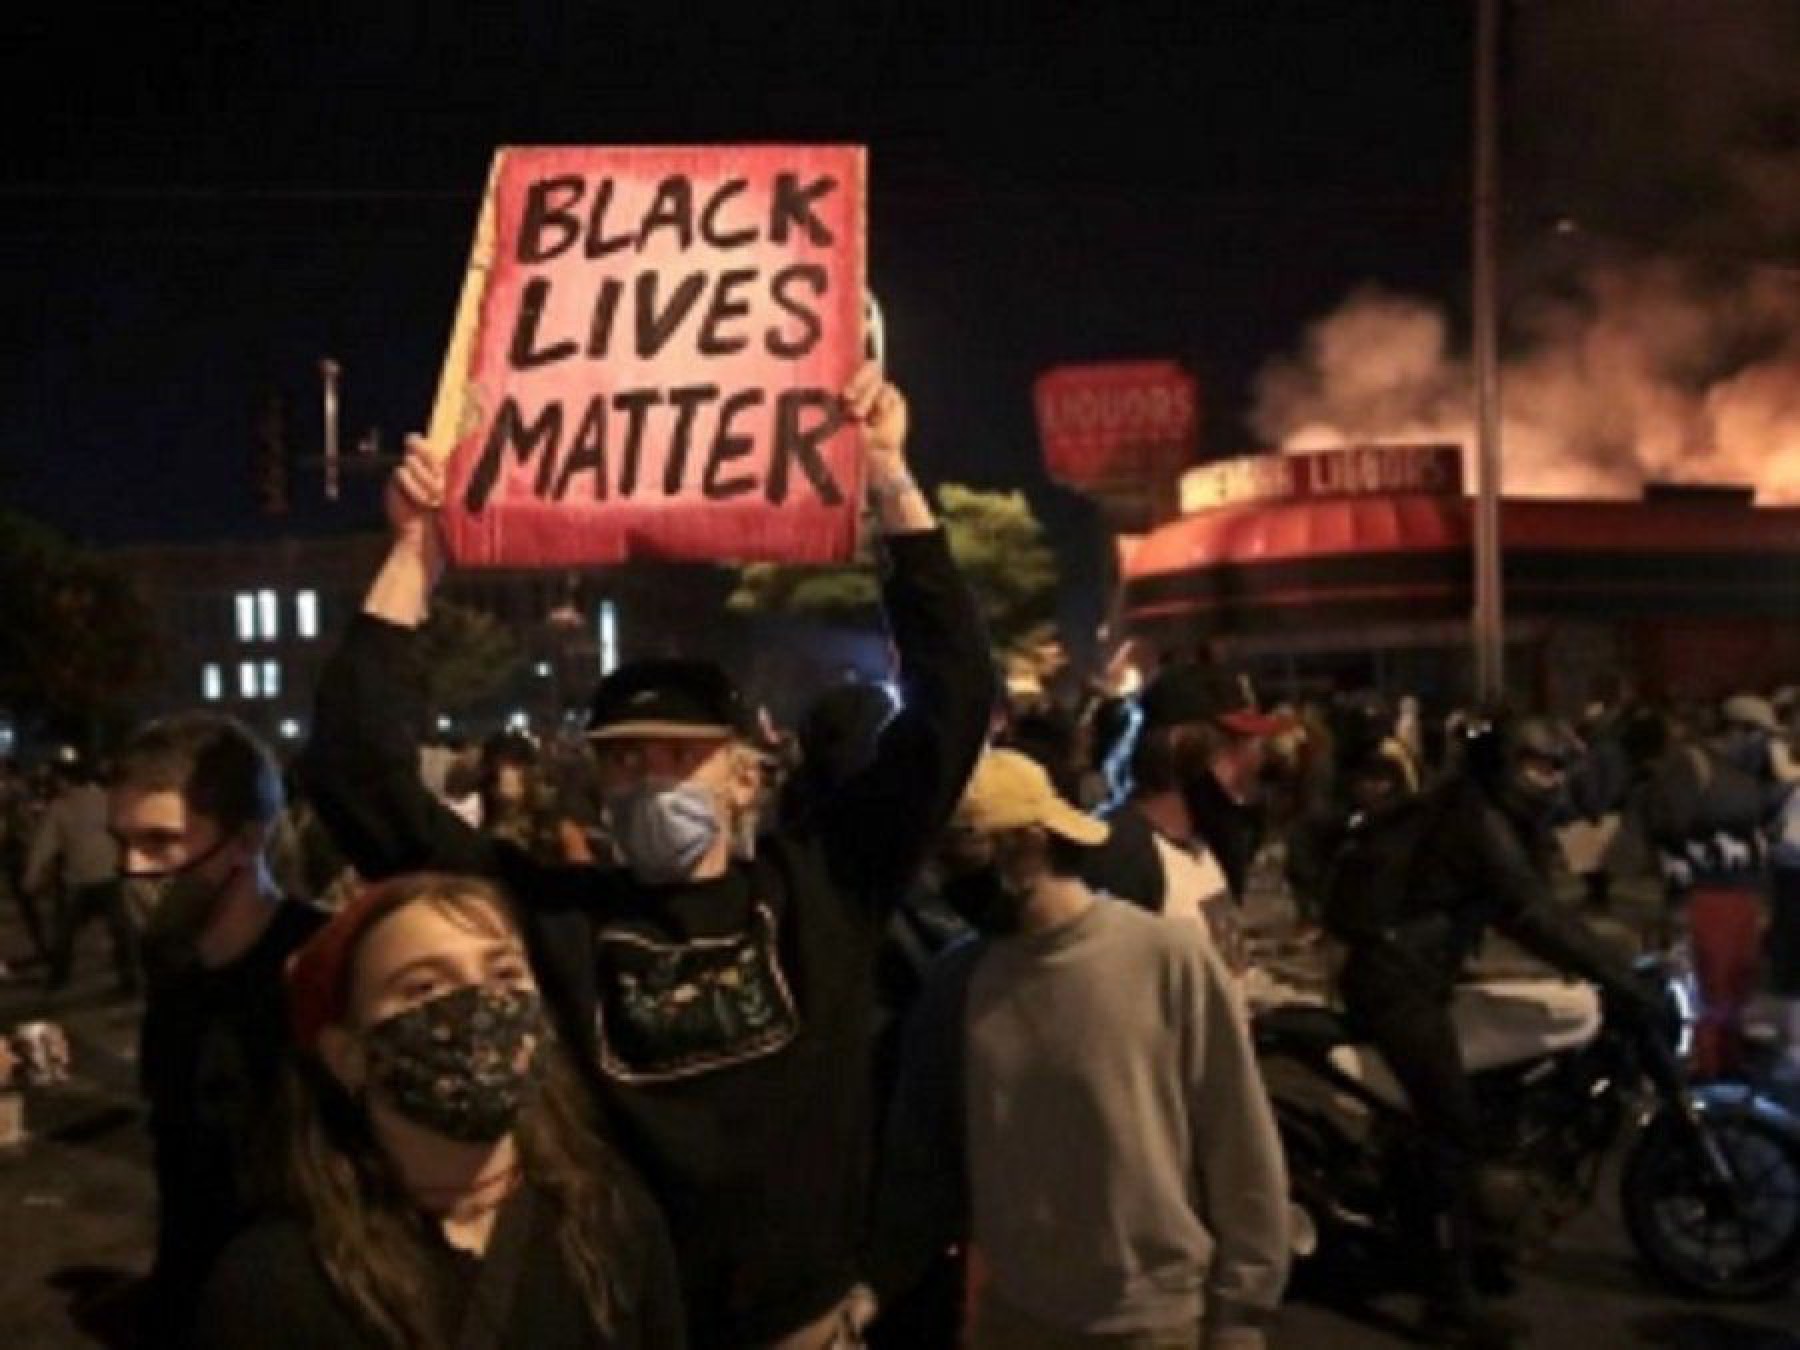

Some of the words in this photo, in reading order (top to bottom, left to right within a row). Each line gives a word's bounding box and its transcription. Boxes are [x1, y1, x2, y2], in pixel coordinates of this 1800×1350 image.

[517, 172, 839, 265] BLACK
[507, 264, 829, 372] LIVES
[464, 385, 851, 513] MATTER
